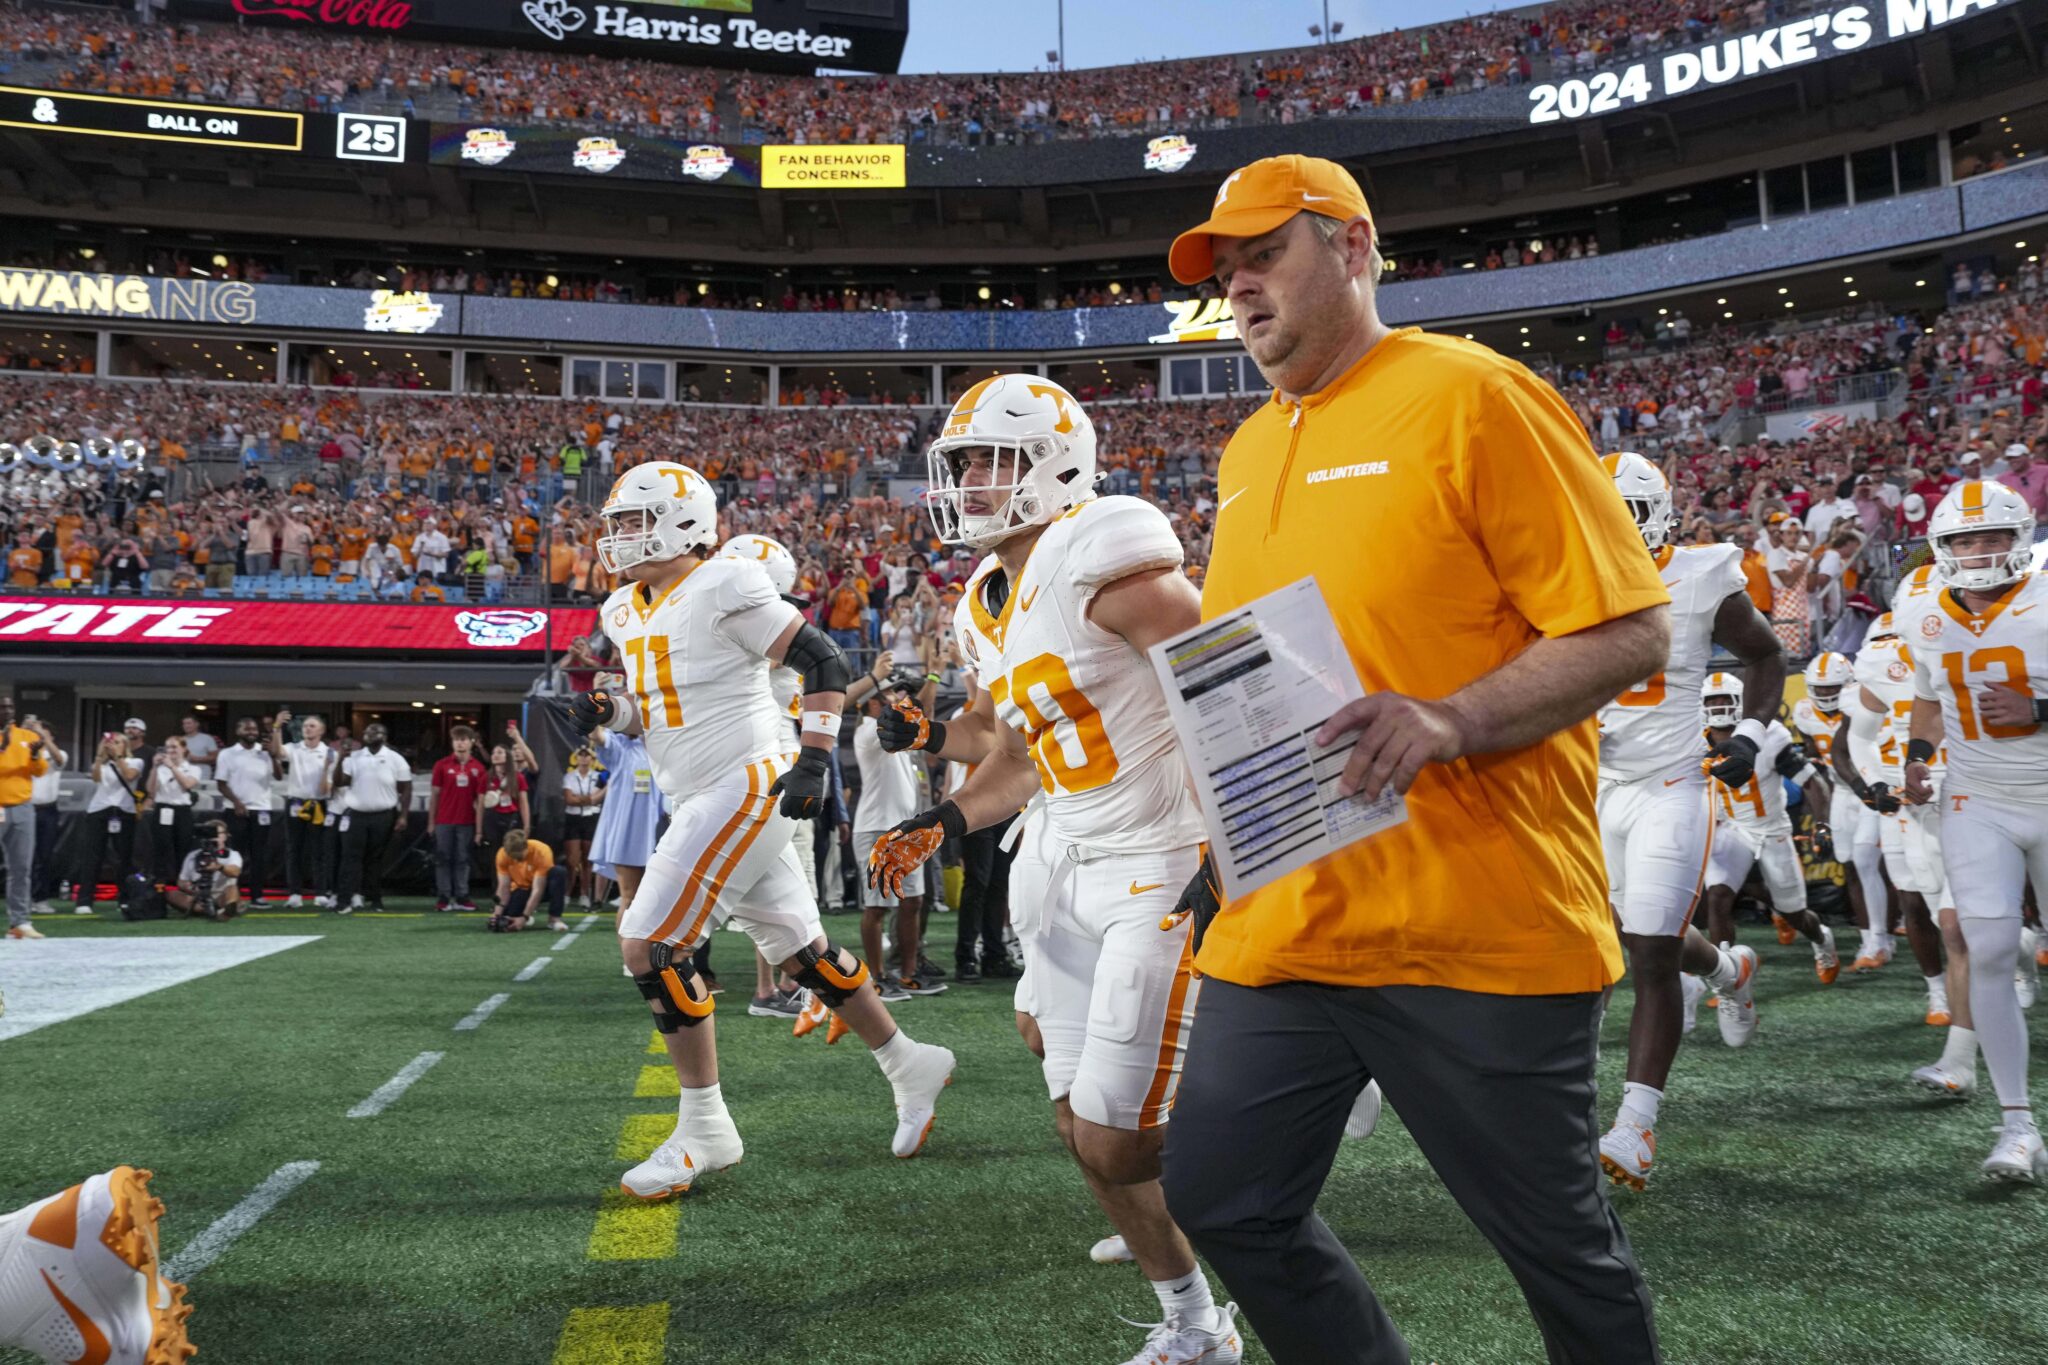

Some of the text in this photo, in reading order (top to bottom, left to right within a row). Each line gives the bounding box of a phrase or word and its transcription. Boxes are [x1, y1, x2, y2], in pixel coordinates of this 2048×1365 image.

[594, 7, 852, 57] Harris Teeter
[1529, 64, 1652, 123] 2024
[32, 98, 58, 123] &
[147, 113, 238, 136] BALL ON
[347, 123, 396, 153] 25
[779, 155, 891, 165] FAN BEHAVIOR
[943, 424, 968, 437] VOLS
[658, 468, 695, 498] T
[1306, 461, 1389, 484] VOLUNTEERS
[752, 539, 779, 560] T
[1970, 619, 1985, 634] T
[820, 714, 831, 726] T
[1952, 795, 1969, 812] T
